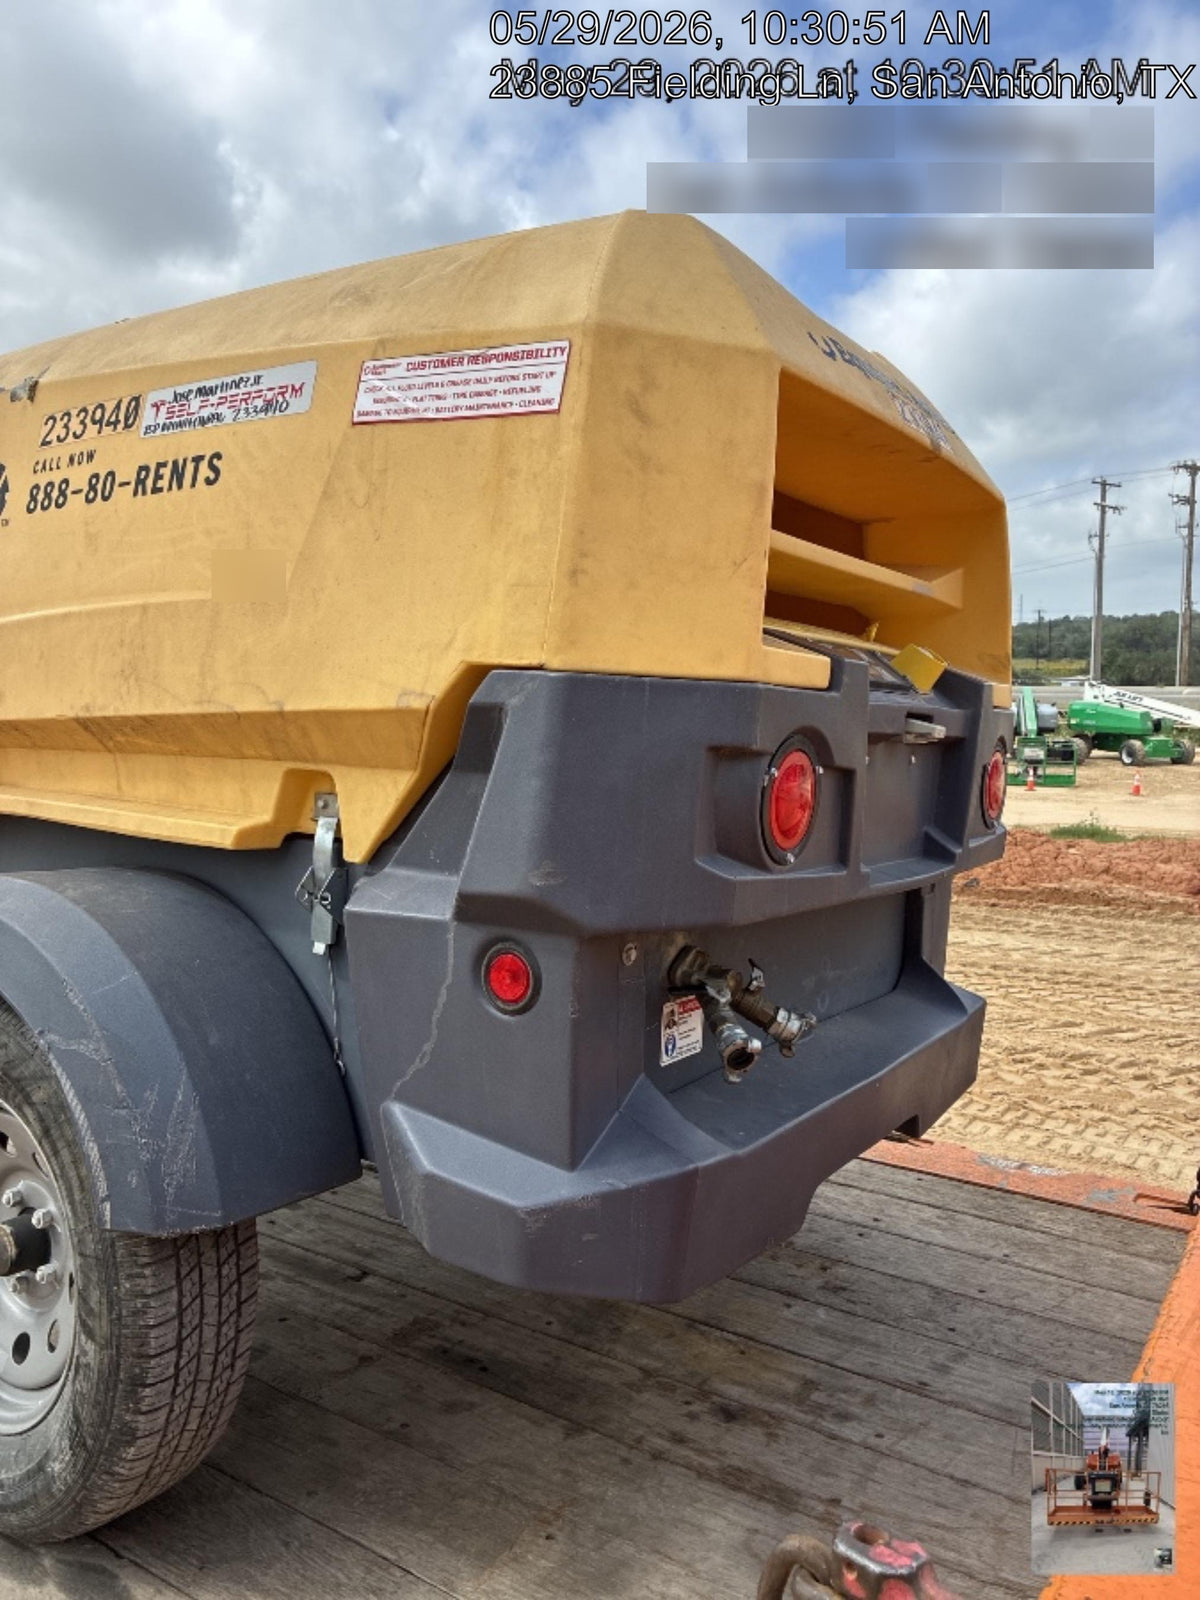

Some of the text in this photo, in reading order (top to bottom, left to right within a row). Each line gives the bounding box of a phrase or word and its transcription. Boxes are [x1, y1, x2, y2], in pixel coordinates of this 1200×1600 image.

[406, 354, 466, 372] CUSTOMER
[467, 346, 568, 366] RESPONSIBILITY
[40, 394, 143, 448] 233940
[33, 449, 97, 474] CALL NOW
[26, 452, 223, 514] 888-80-RENTS
